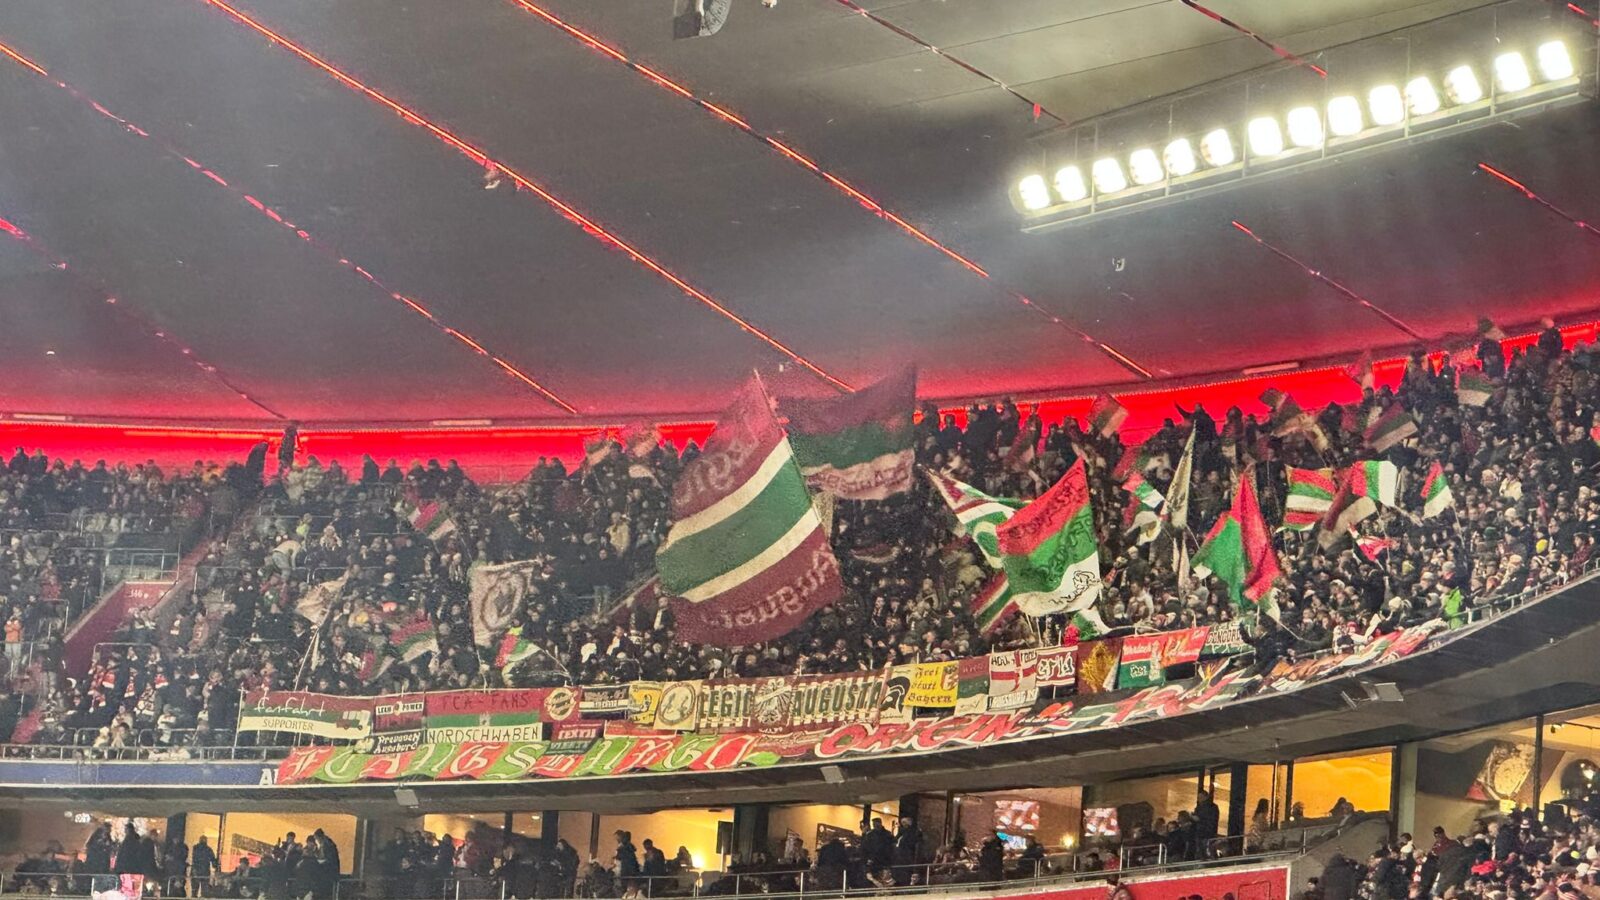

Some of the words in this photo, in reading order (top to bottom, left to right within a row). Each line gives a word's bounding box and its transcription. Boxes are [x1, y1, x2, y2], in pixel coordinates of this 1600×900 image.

[792, 680, 881, 715] AUGUSTA
[402, 703, 423, 711] POWER
[262, 719, 314, 731] SUPPORTER
[429, 726, 538, 743] NORDSCHWABEN
